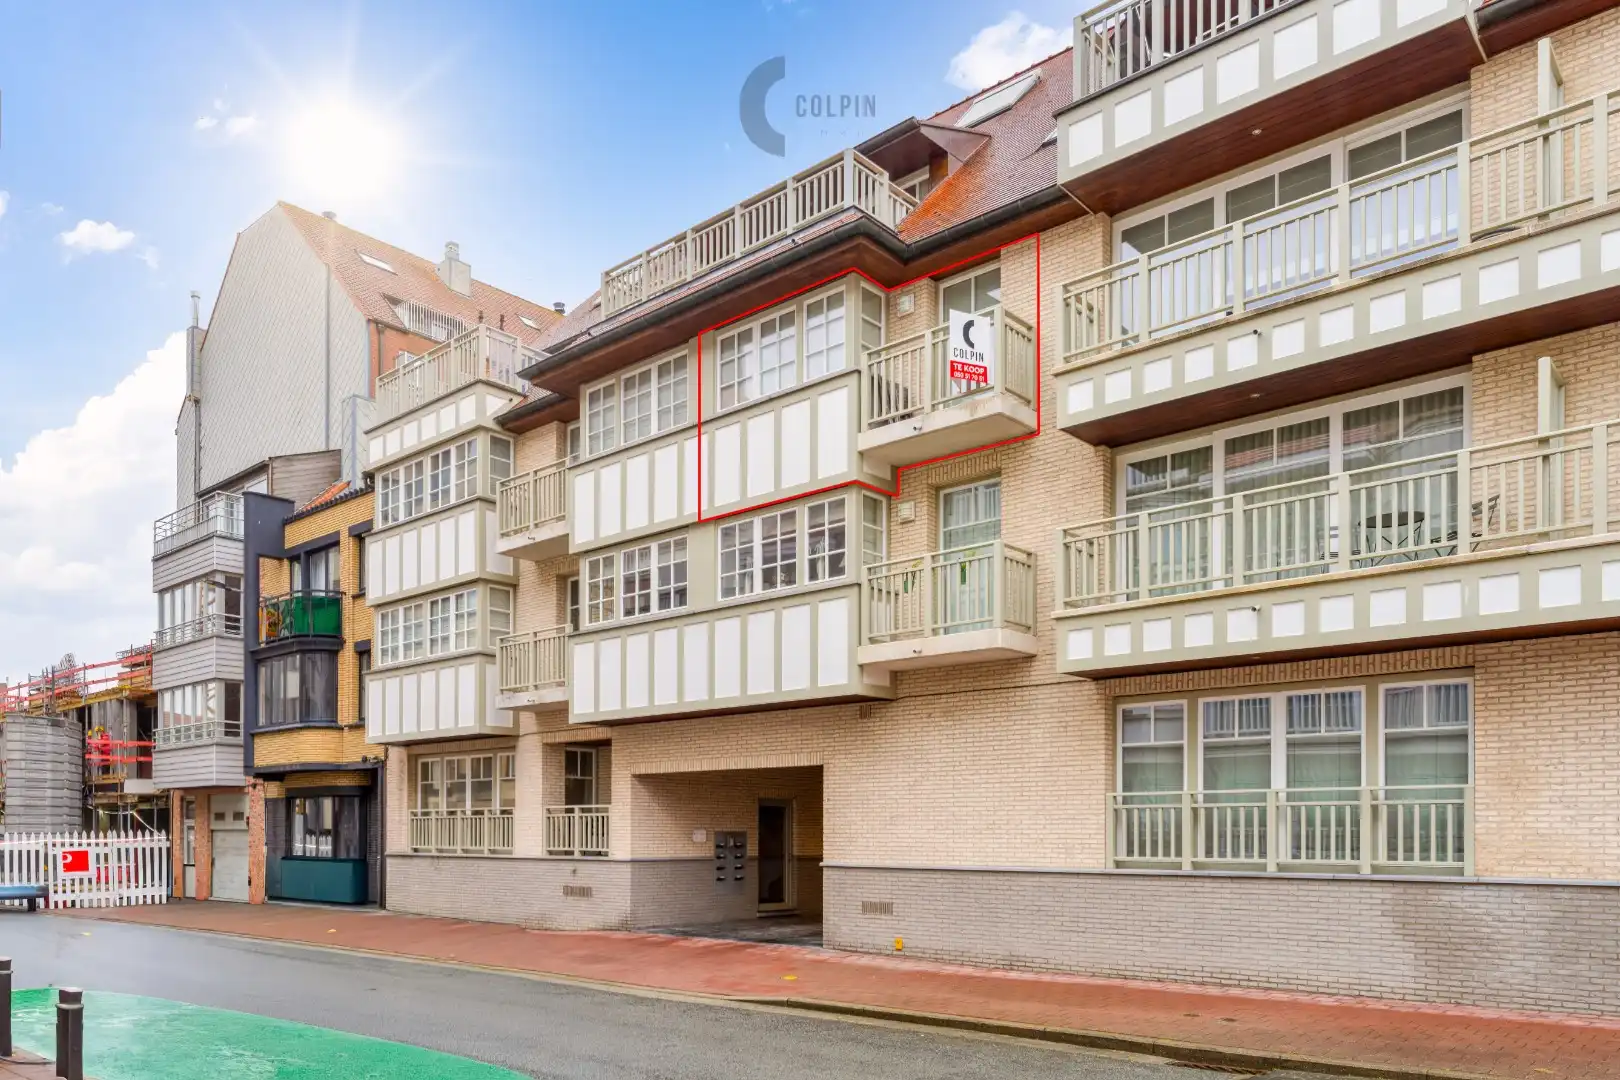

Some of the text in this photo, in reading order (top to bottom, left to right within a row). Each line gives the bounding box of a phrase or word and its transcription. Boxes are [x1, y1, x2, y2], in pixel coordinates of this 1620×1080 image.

[953, 347, 984, 362] COLPIN
[953, 363, 984, 374] TE KOOP
